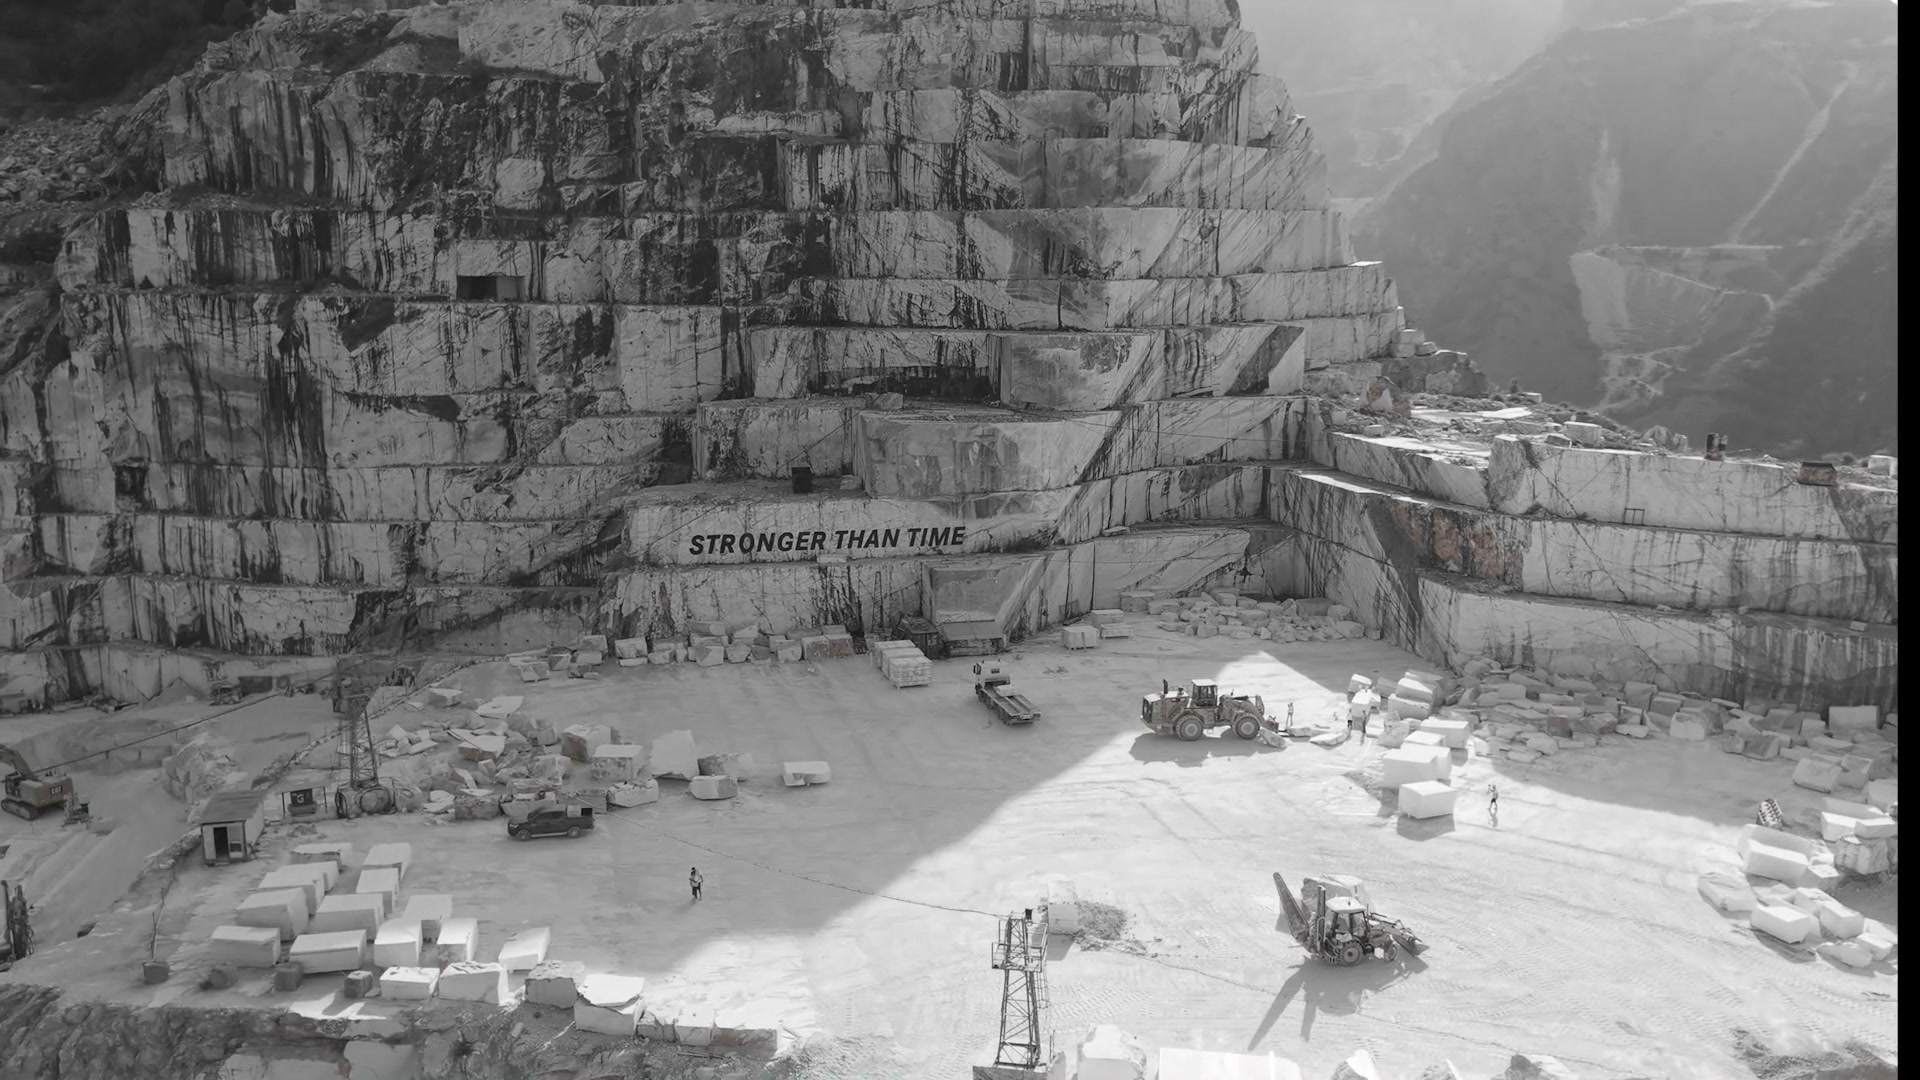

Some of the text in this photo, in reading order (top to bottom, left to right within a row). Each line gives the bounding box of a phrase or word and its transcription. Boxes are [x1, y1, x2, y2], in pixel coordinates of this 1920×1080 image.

[689, 526, 966, 555] STRONGER THAN TIME
